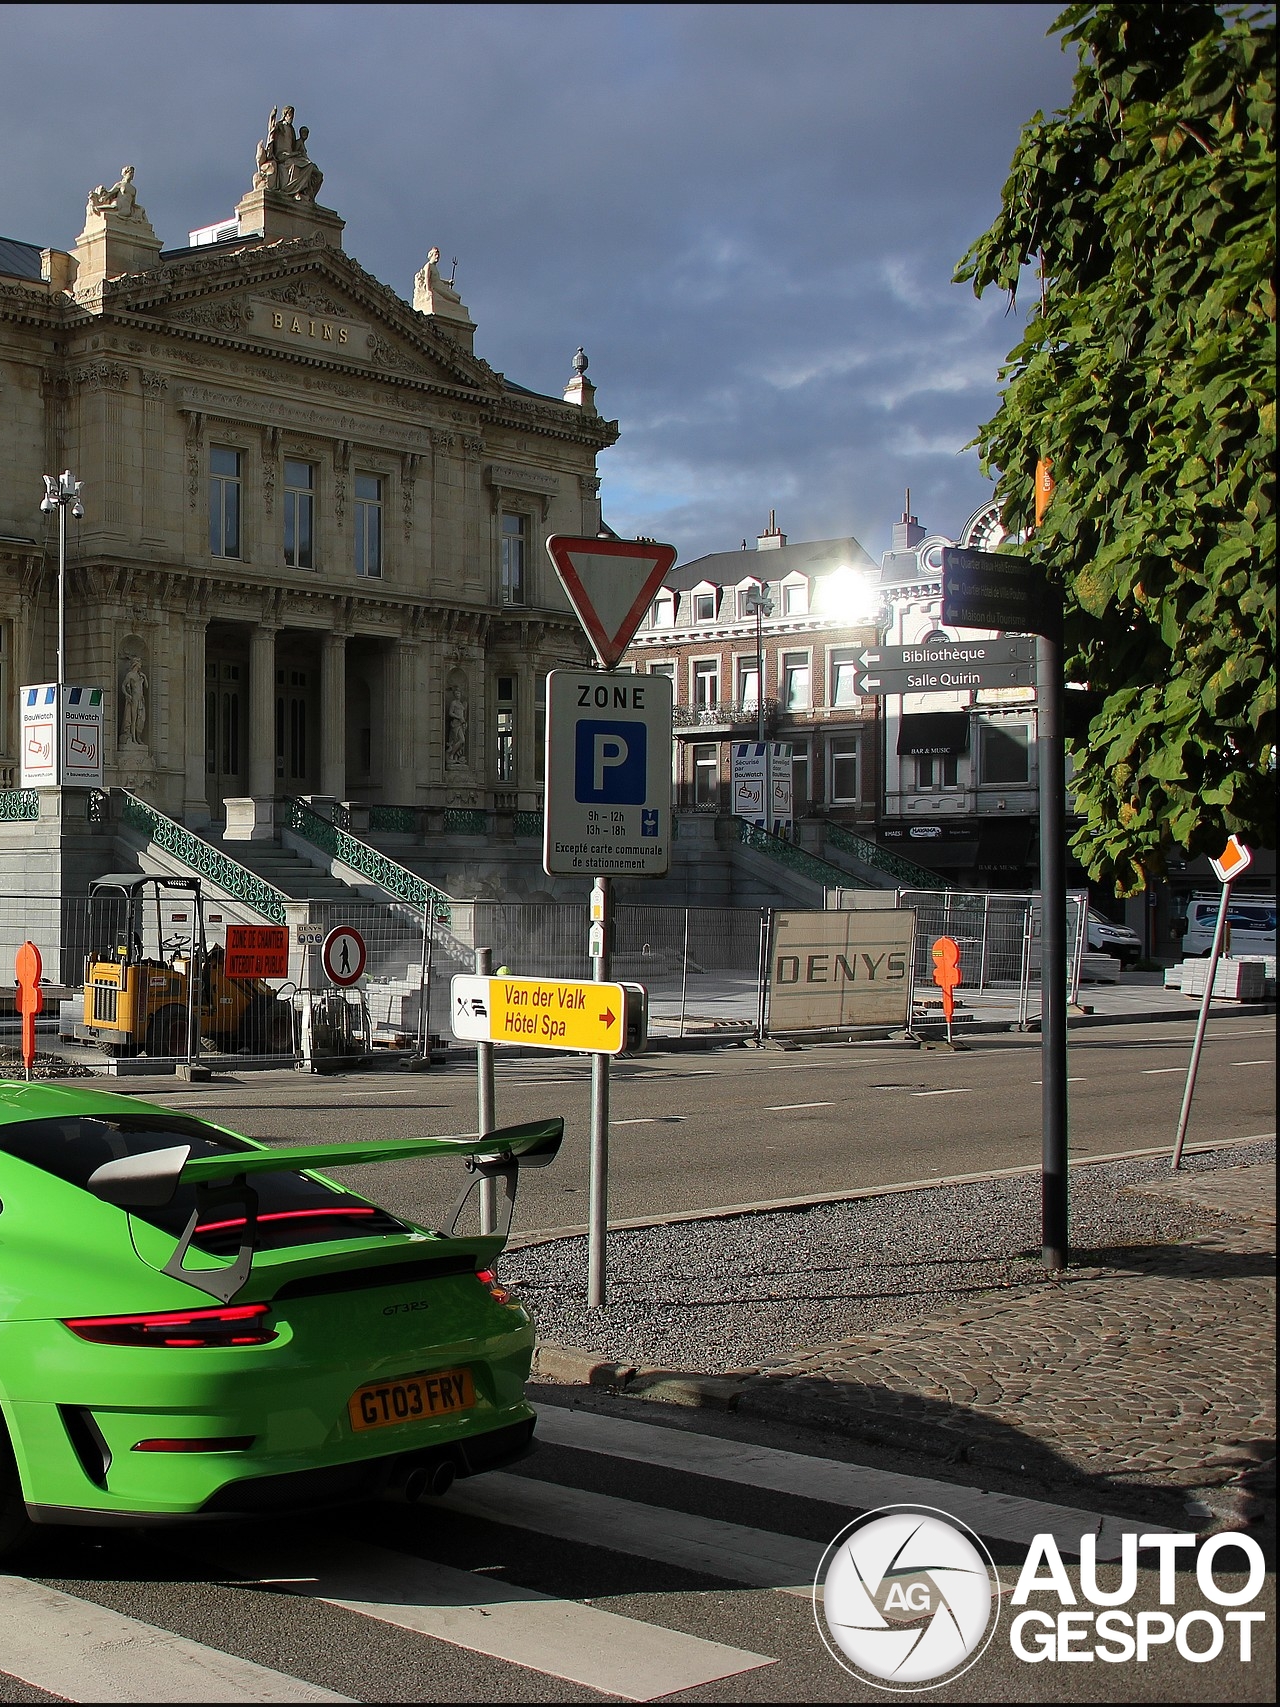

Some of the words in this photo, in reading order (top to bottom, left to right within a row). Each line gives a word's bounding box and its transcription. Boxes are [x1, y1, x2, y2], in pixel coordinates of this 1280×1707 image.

[273, 312, 348, 344] BAINS
[961, 608, 985, 622] Maison
[986, 610, 996, 623] du
[996, 611, 1026, 626] Tourisme
[902, 648, 986, 664] Bibliothèque
[907, 674, 938, 688] Salle
[940, 672, 981, 687] Quirin
[577, 684, 645, 710] ZONE
[23, 712, 54, 722] BauWatch
[65, 711, 100, 722] BauWatch
[588, 810, 599, 822] 9h
[610, 810, 625, 822] 12h
[586, 824, 601, 835] 13h
[611, 824, 626, 836] 18h
[555, 842, 588, 857] Excepté
[590, 844, 613, 854] carte
[615, 844, 663, 856] communale
[572, 856, 582, 868] de
[585, 857, 646, 869] stationnement
[232, 929, 247, 949] ZONE
[248, 930, 256, 949] DE
[257, 930, 284, 949] CHANTIER
[229, 955, 255, 974] INTERDIT
[255, 955, 263, 974] AU
[265, 955, 284, 974] PUBLIC
[776, 952, 906, 985] DENYS
[504, 984, 529, 1006] Van
[532, 986, 554, 1008] der
[557, 987, 586, 1009] Valk
[504, 1011, 538, 1034] Hôtel
[541, 1014, 566, 1041] Spa
[360, 1383, 423, 1424] GT03
[425, 1374, 464, 1411] FRY
